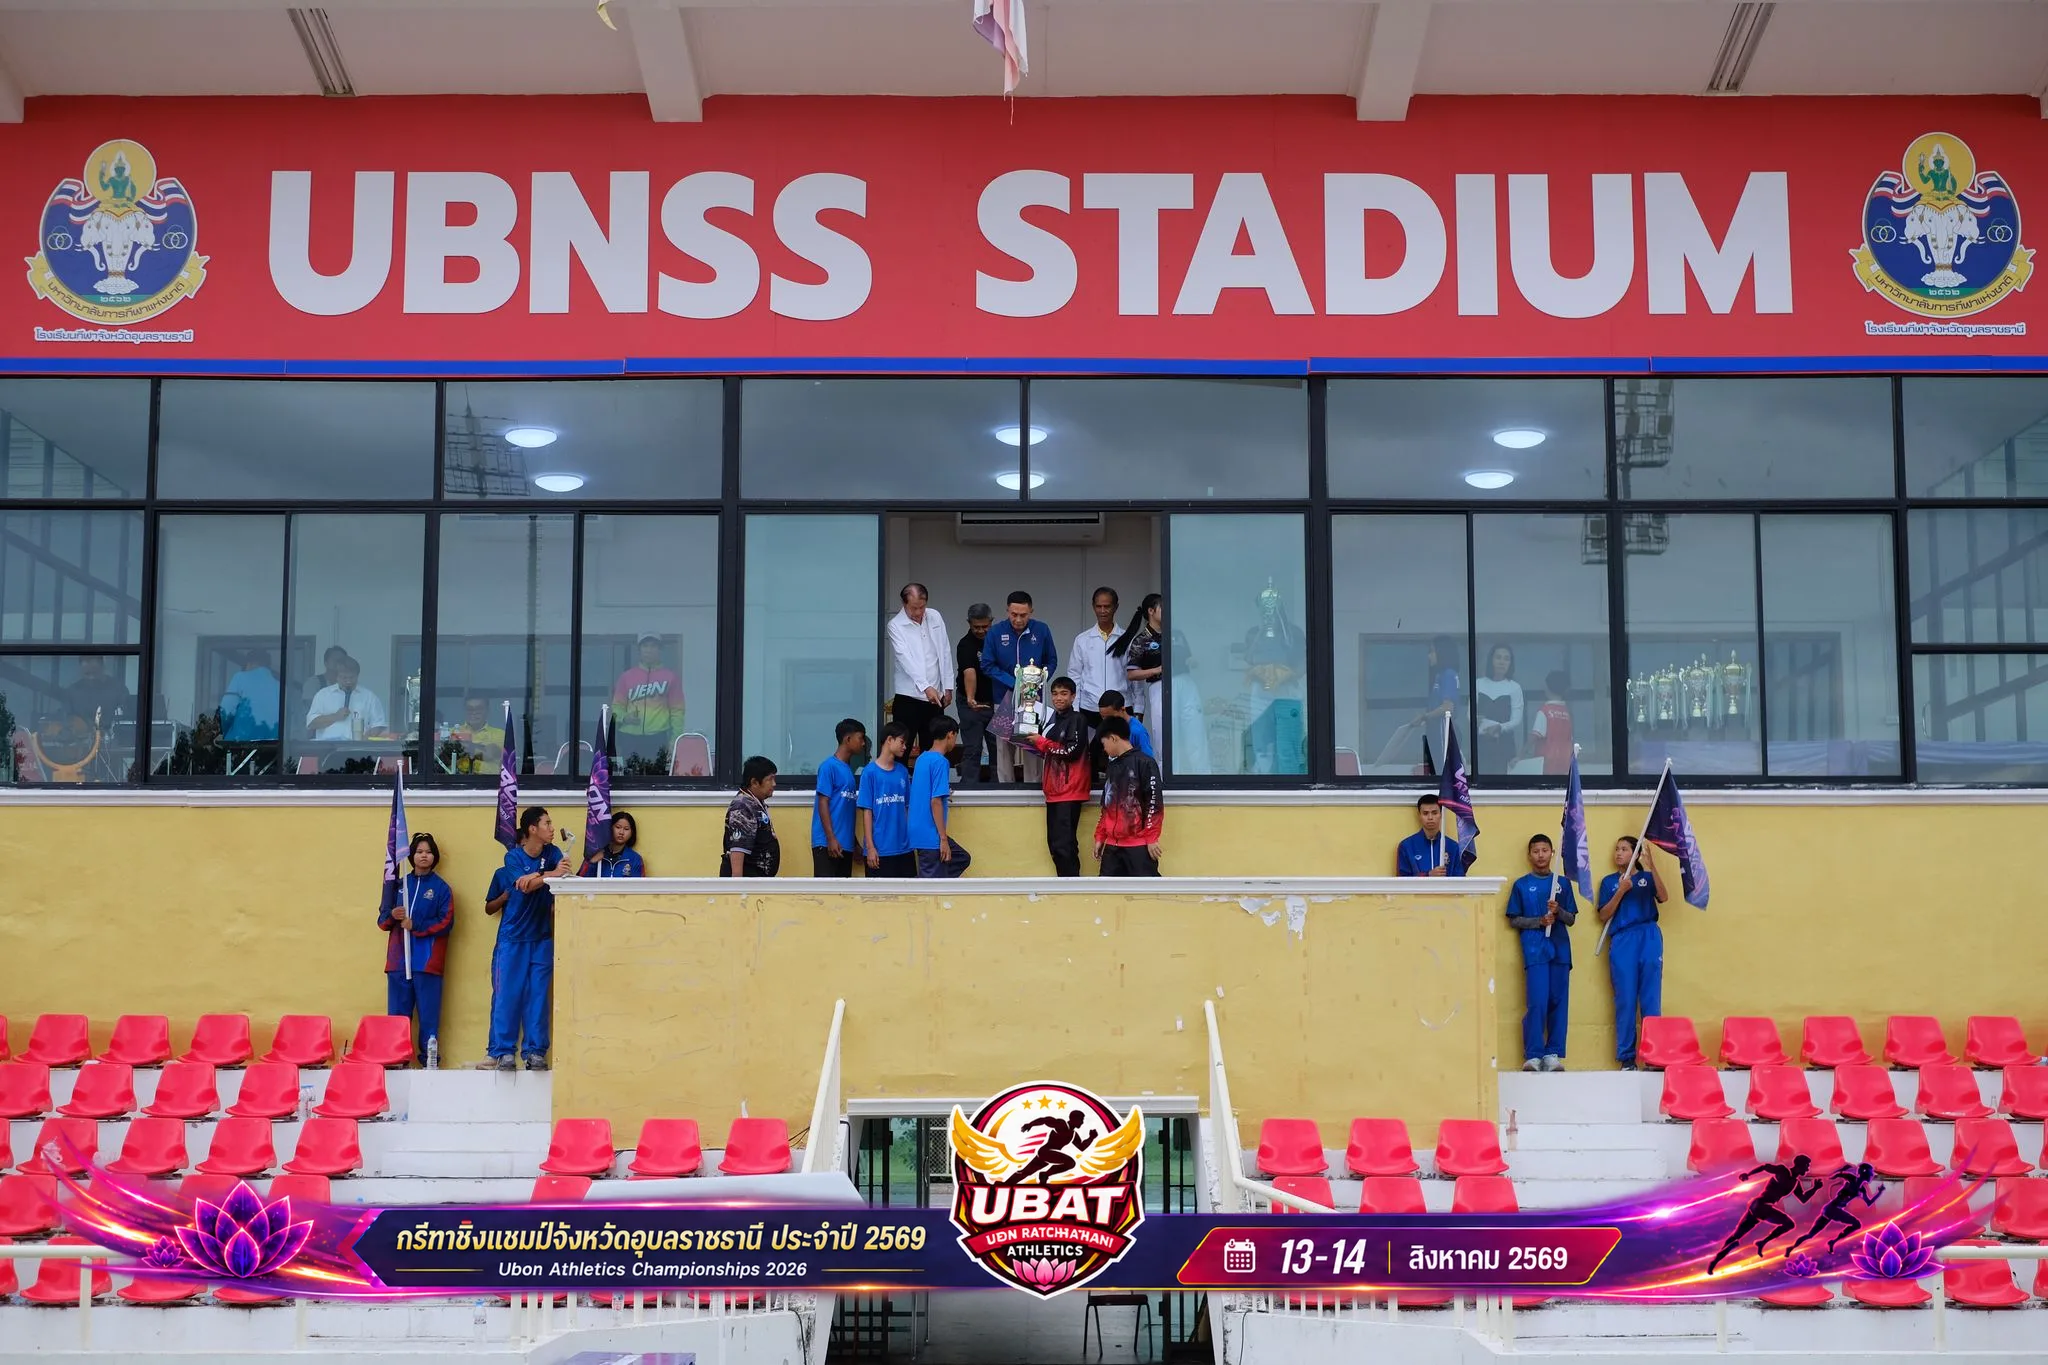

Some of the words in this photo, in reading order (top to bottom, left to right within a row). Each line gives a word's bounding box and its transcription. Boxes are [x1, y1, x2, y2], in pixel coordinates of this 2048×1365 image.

[269, 171, 872, 320] UBNSS
[976, 170, 1792, 318] STADIUM
[48, 282, 184, 319] มหาวิทยาลัยการกีฬาแห่งชาติ
[1875, 274, 2013, 312] มหาวิทยาลัยการกีฬาแห่งชาติ
[36, 328, 193, 343] โรงเรียนกีฬาจังหวัดอุบลราชธานี
[1866, 322, 2025, 336] โรงเรียนกีฬาจังหวัดอุบลราชธานี
